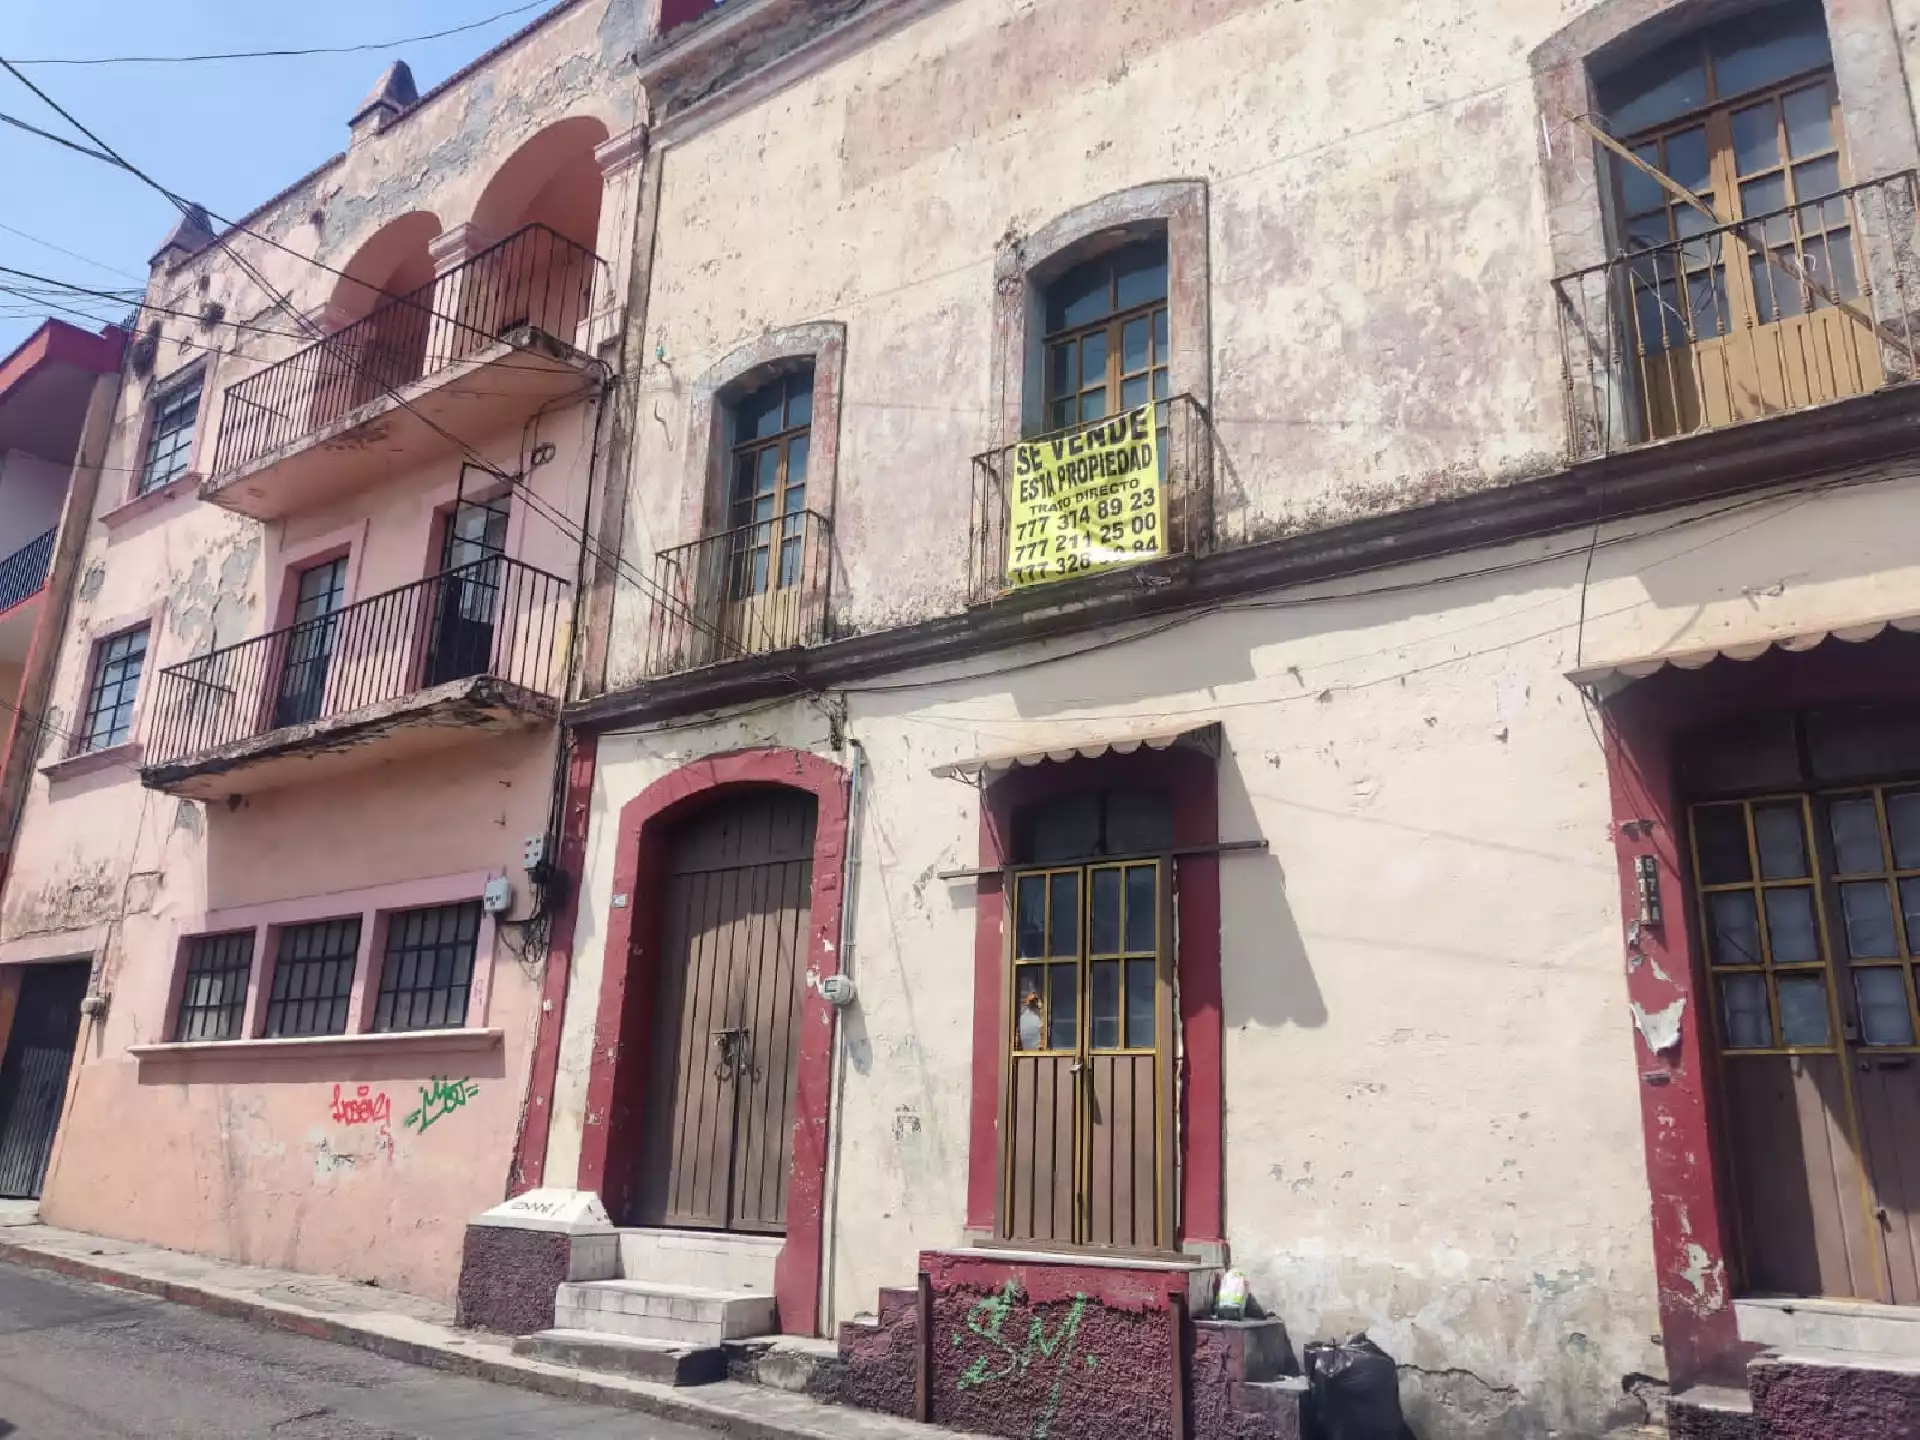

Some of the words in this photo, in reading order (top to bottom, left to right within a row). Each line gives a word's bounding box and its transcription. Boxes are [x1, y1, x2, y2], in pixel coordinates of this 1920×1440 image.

[1017, 445, 1042, 476] SE
[1051, 408, 1148, 460] VENDE
[1020, 470, 1056, 504] ESTA
[1057, 444, 1152, 491] PROPIEDAD
[1030, 497, 1070, 515] TRATO
[1076, 479, 1139, 504] DIRECTO
[1015, 538, 1048, 564] 777
[1056, 530, 1090, 553] 211
[1100, 521, 1124, 544] 25
[1132, 512, 1155, 534] 00
[1016, 516, 1050, 541] 777
[1098, 498, 1122, 519] 89
[1130, 487, 1154, 511] 23
